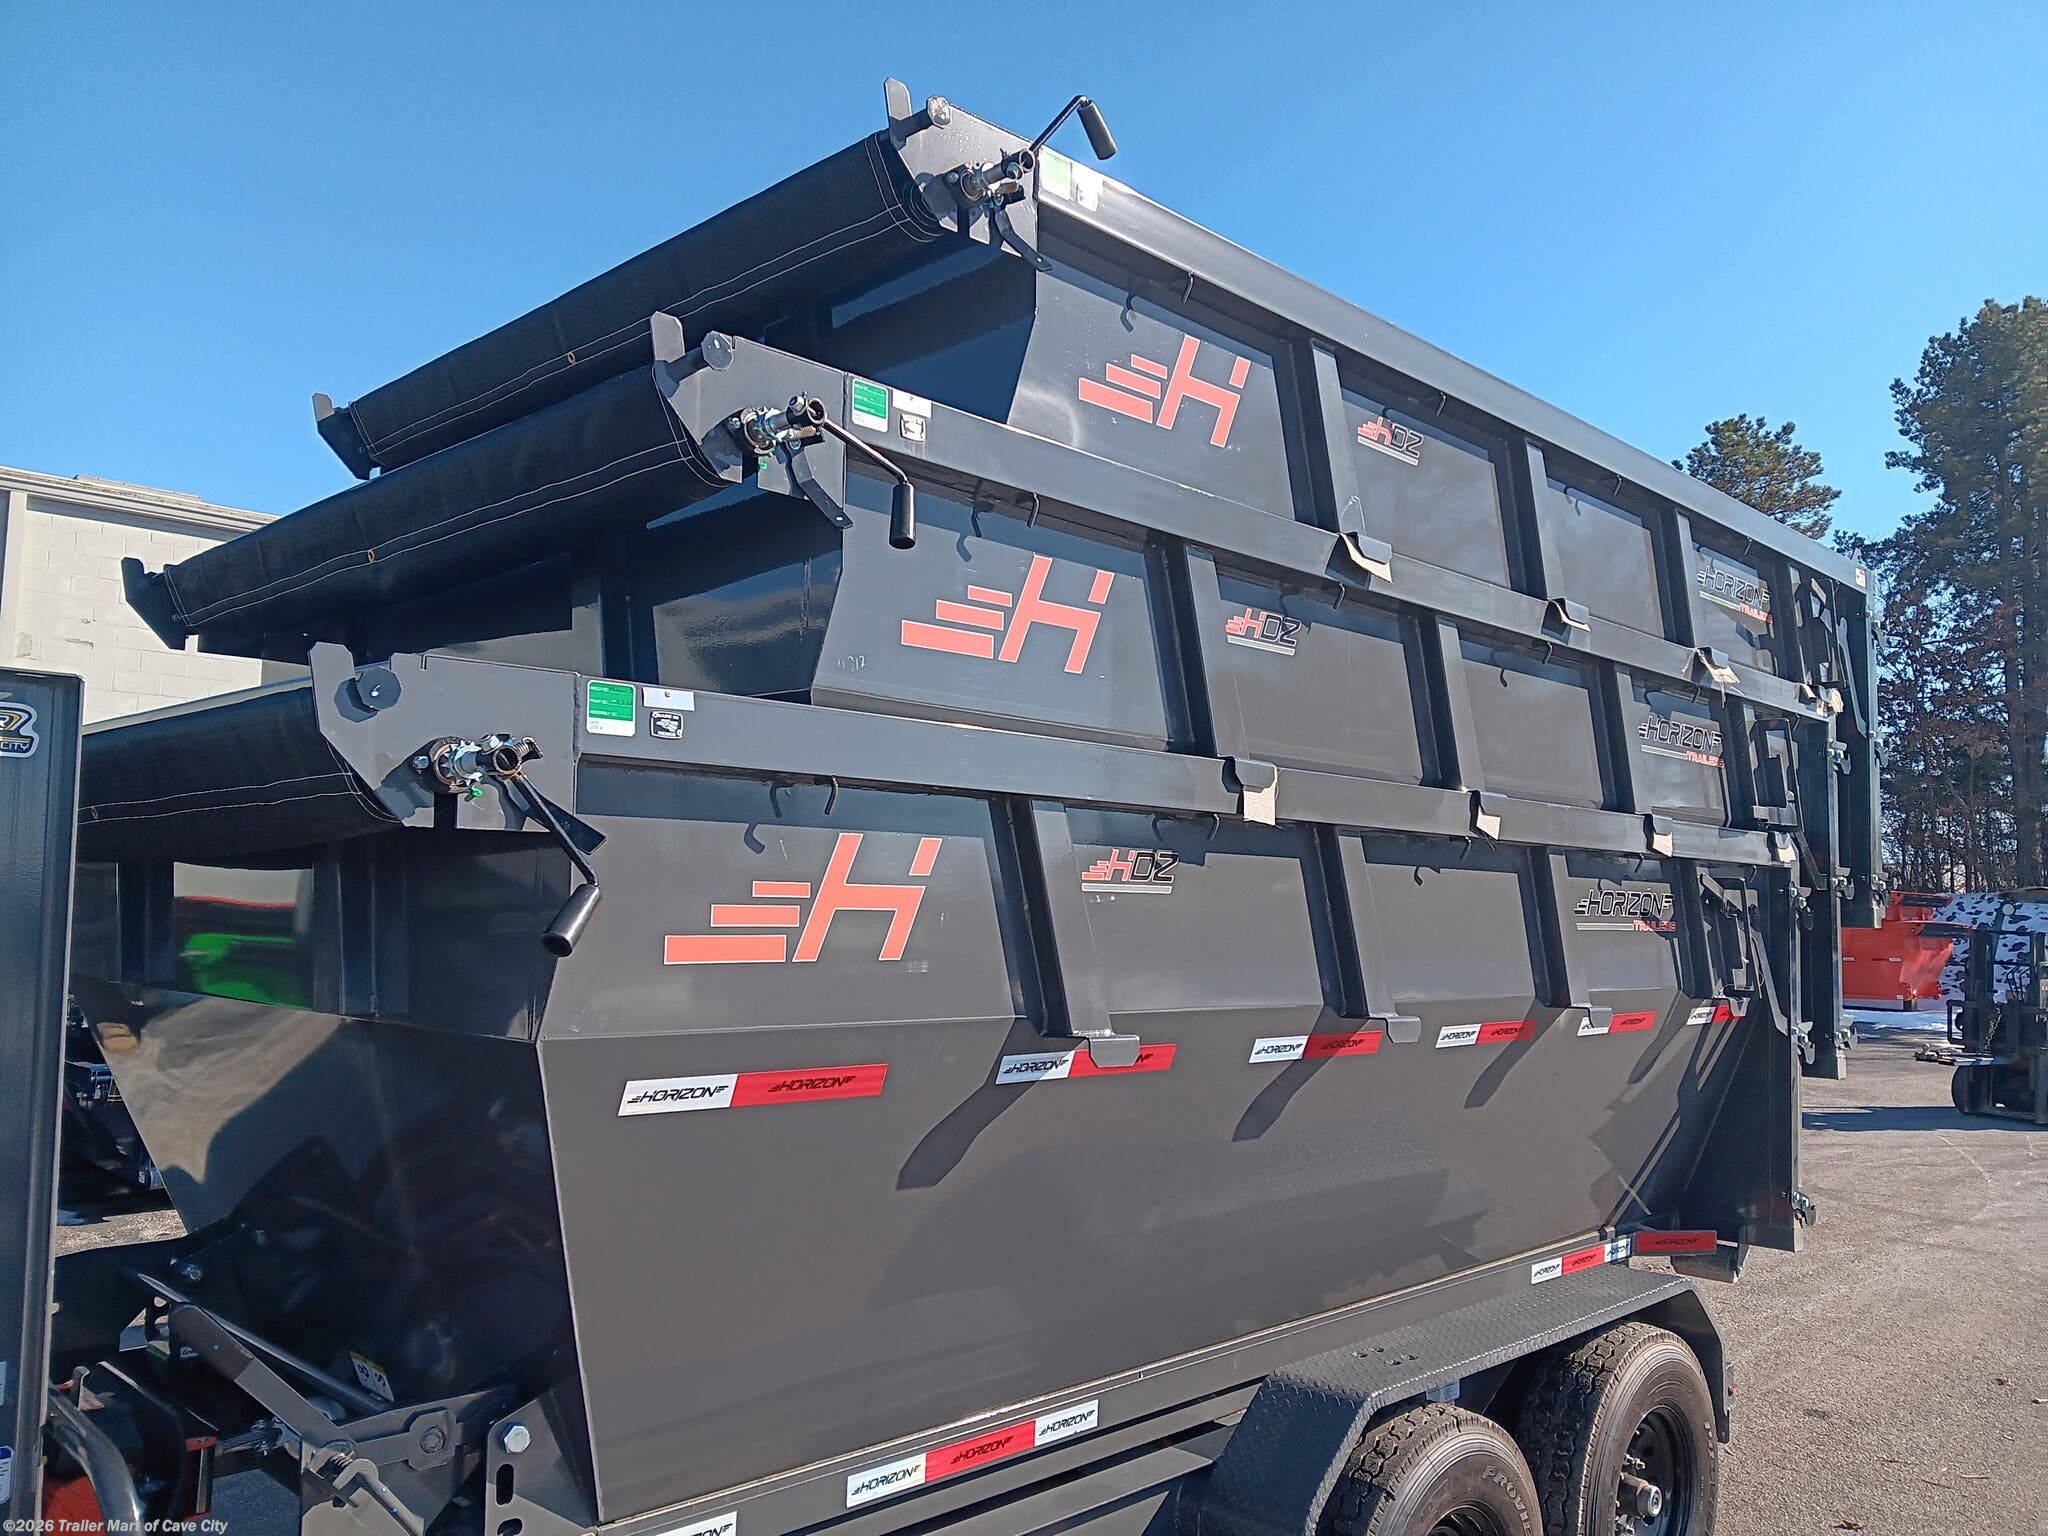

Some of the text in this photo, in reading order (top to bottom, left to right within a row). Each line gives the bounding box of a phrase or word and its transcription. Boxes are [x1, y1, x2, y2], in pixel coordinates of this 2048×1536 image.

[1700, 565, 1767, 609] HORIZON
[1641, 714, 1718, 753] HORIZON
[1580, 888, 1669, 918] HORIZON
[1007, 1060, 1065, 1073] HORIZON
[634, 1076, 852, 1103] HORIZON HORIZON
[855, 1411, 1093, 1493] HORIZON HORIZON HORIZON
